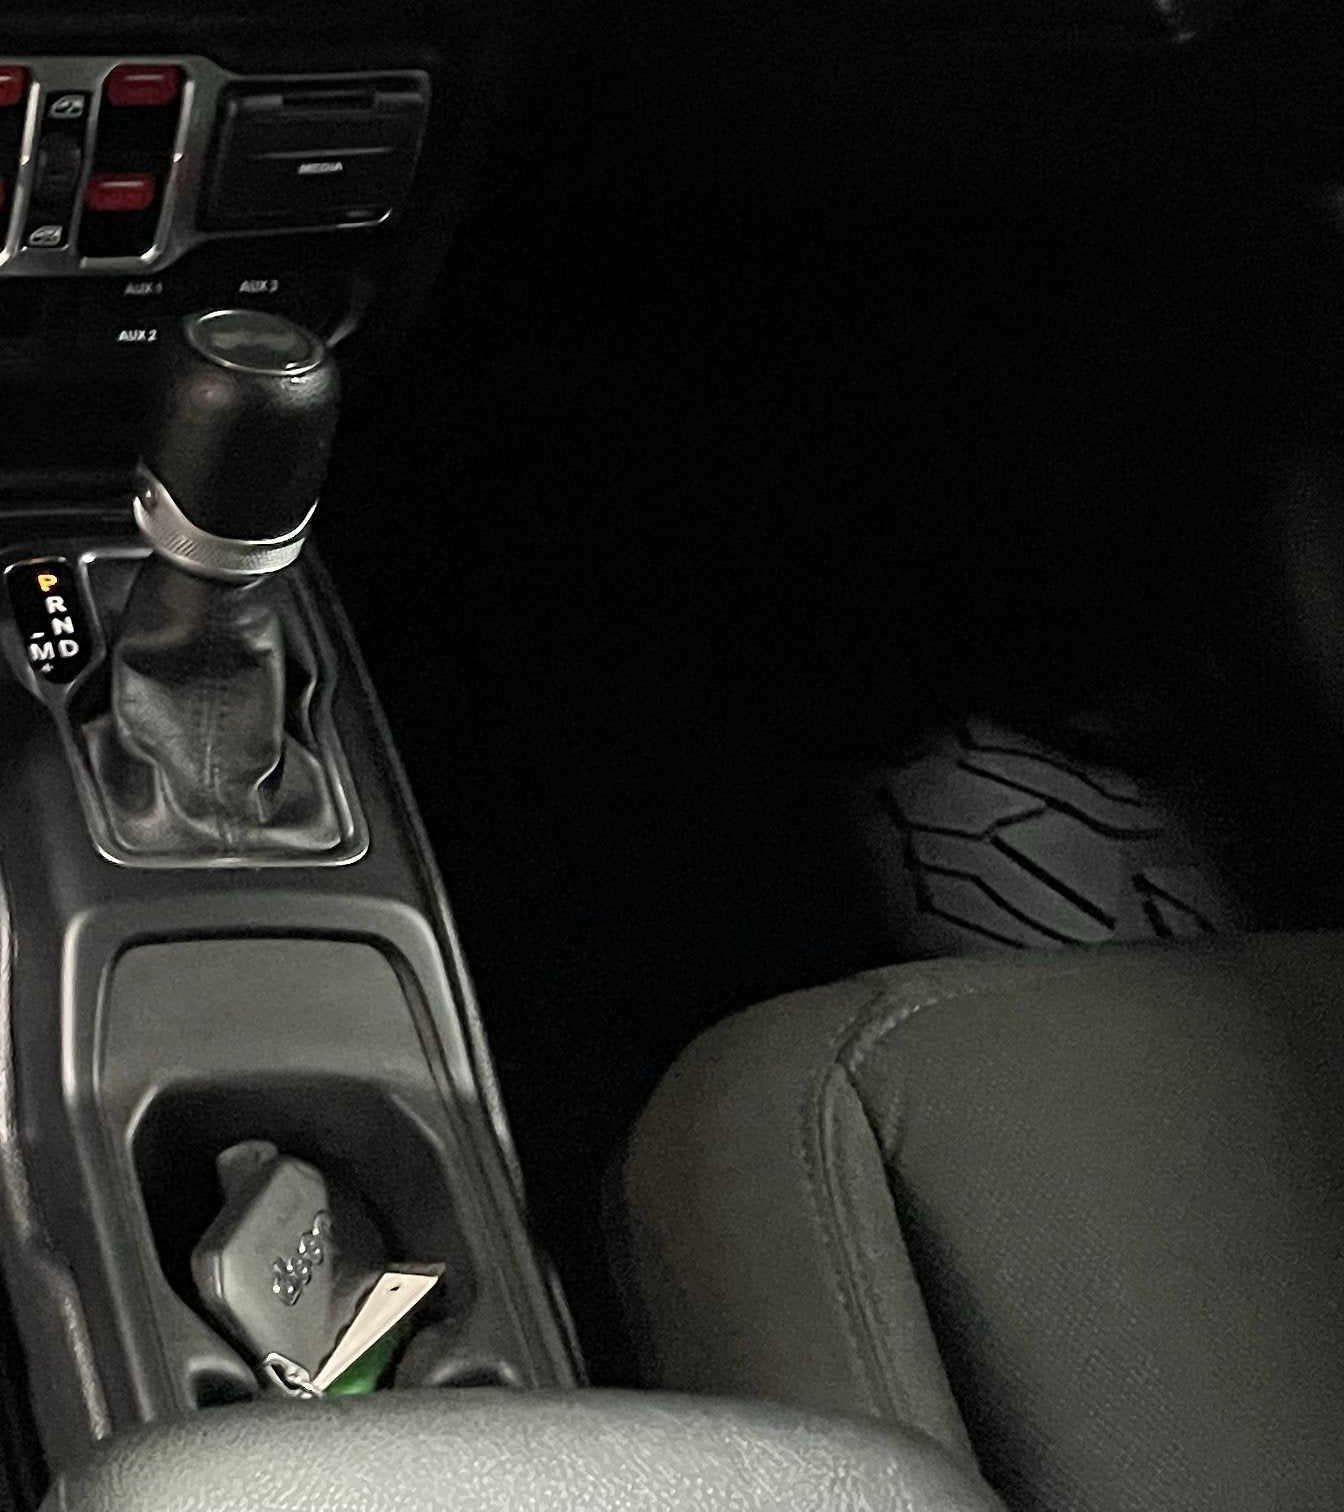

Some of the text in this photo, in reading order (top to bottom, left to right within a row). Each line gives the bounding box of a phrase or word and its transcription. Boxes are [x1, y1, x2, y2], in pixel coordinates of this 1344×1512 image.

[298, 160, 344, 175] MEDIA
[124, 282, 153, 295] AUX
[238, 279, 268, 293] AUX
[118, 329, 158, 342] AUX 2
[37, 574, 58, 593] P
[45, 595, 68, 615] R
[51, 616, 75, 637] N
[29, 641, 56, 661] M
[58, 639, 80, 658] D
